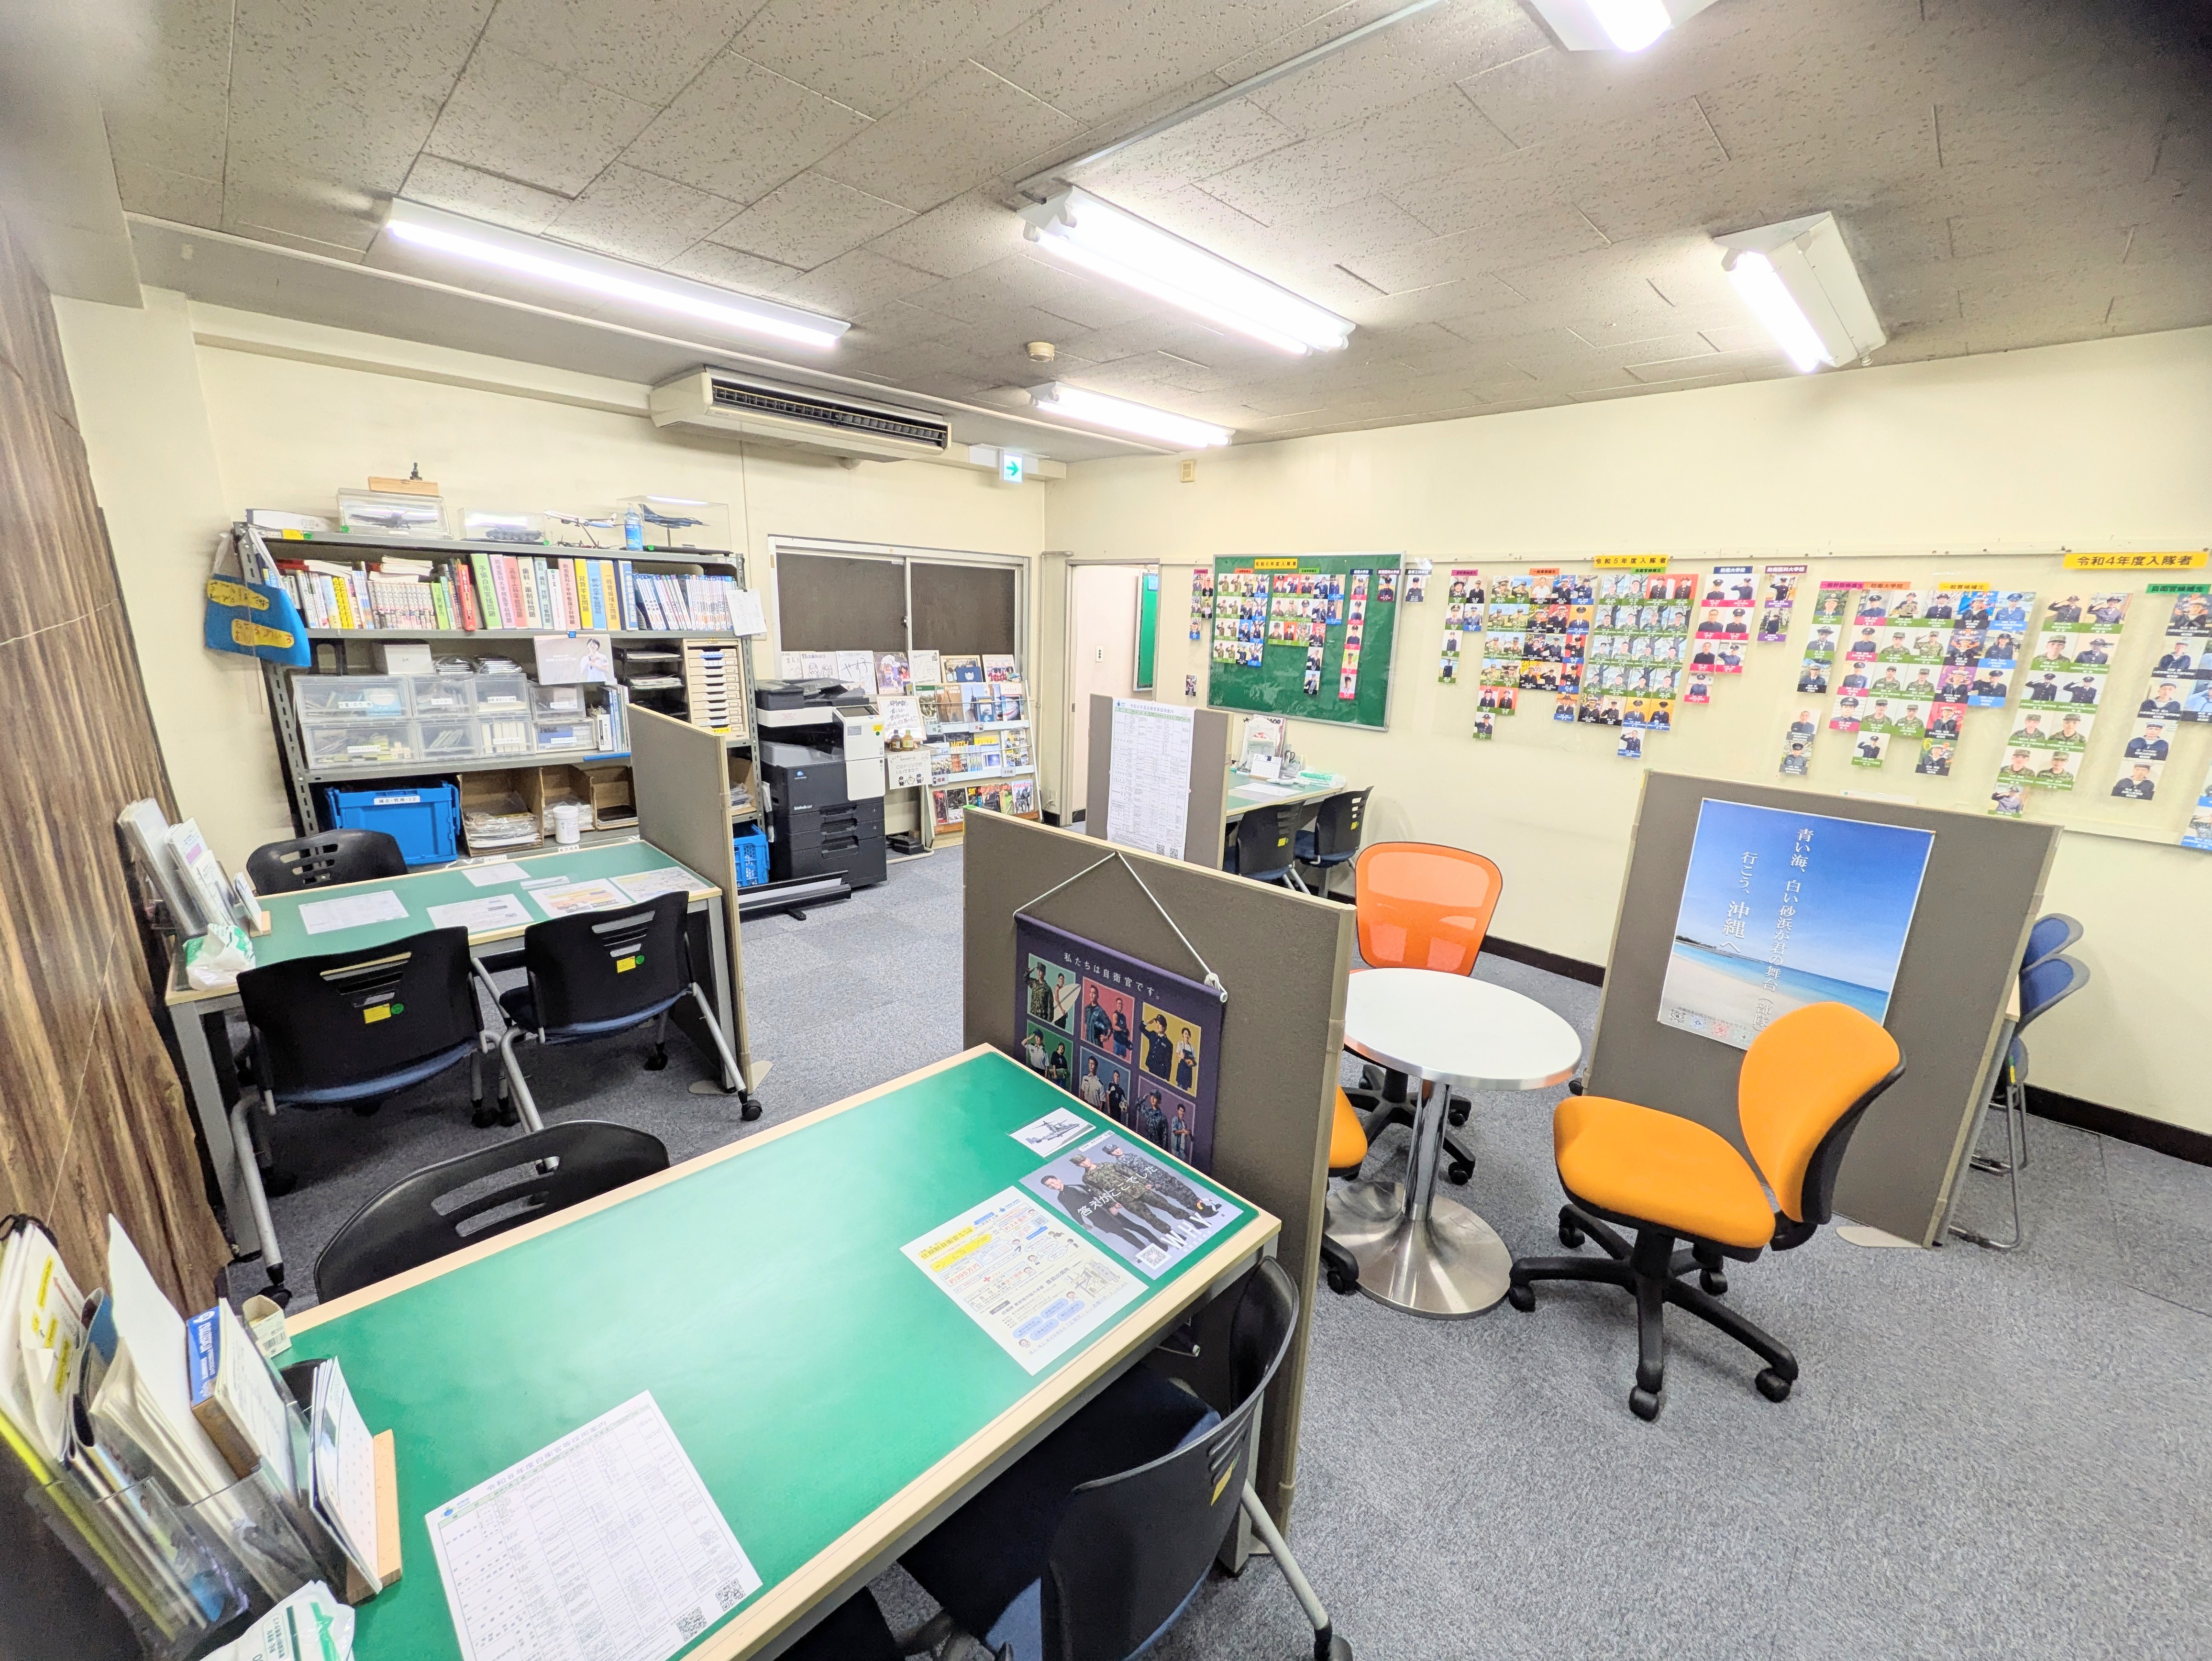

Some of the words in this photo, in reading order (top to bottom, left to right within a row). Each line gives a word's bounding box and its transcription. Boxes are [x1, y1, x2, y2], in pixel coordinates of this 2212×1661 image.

[2077, 555, 2193, 566] 令和4年度入隊者
[1064, 952, 1160, 1000] 私たちは自衛官です。
[1077, 1165, 1158, 1217] 答えがここでした
[1160, 1212, 1212, 1250] WHY
[949, 1262, 981, 1285] 約395万円
